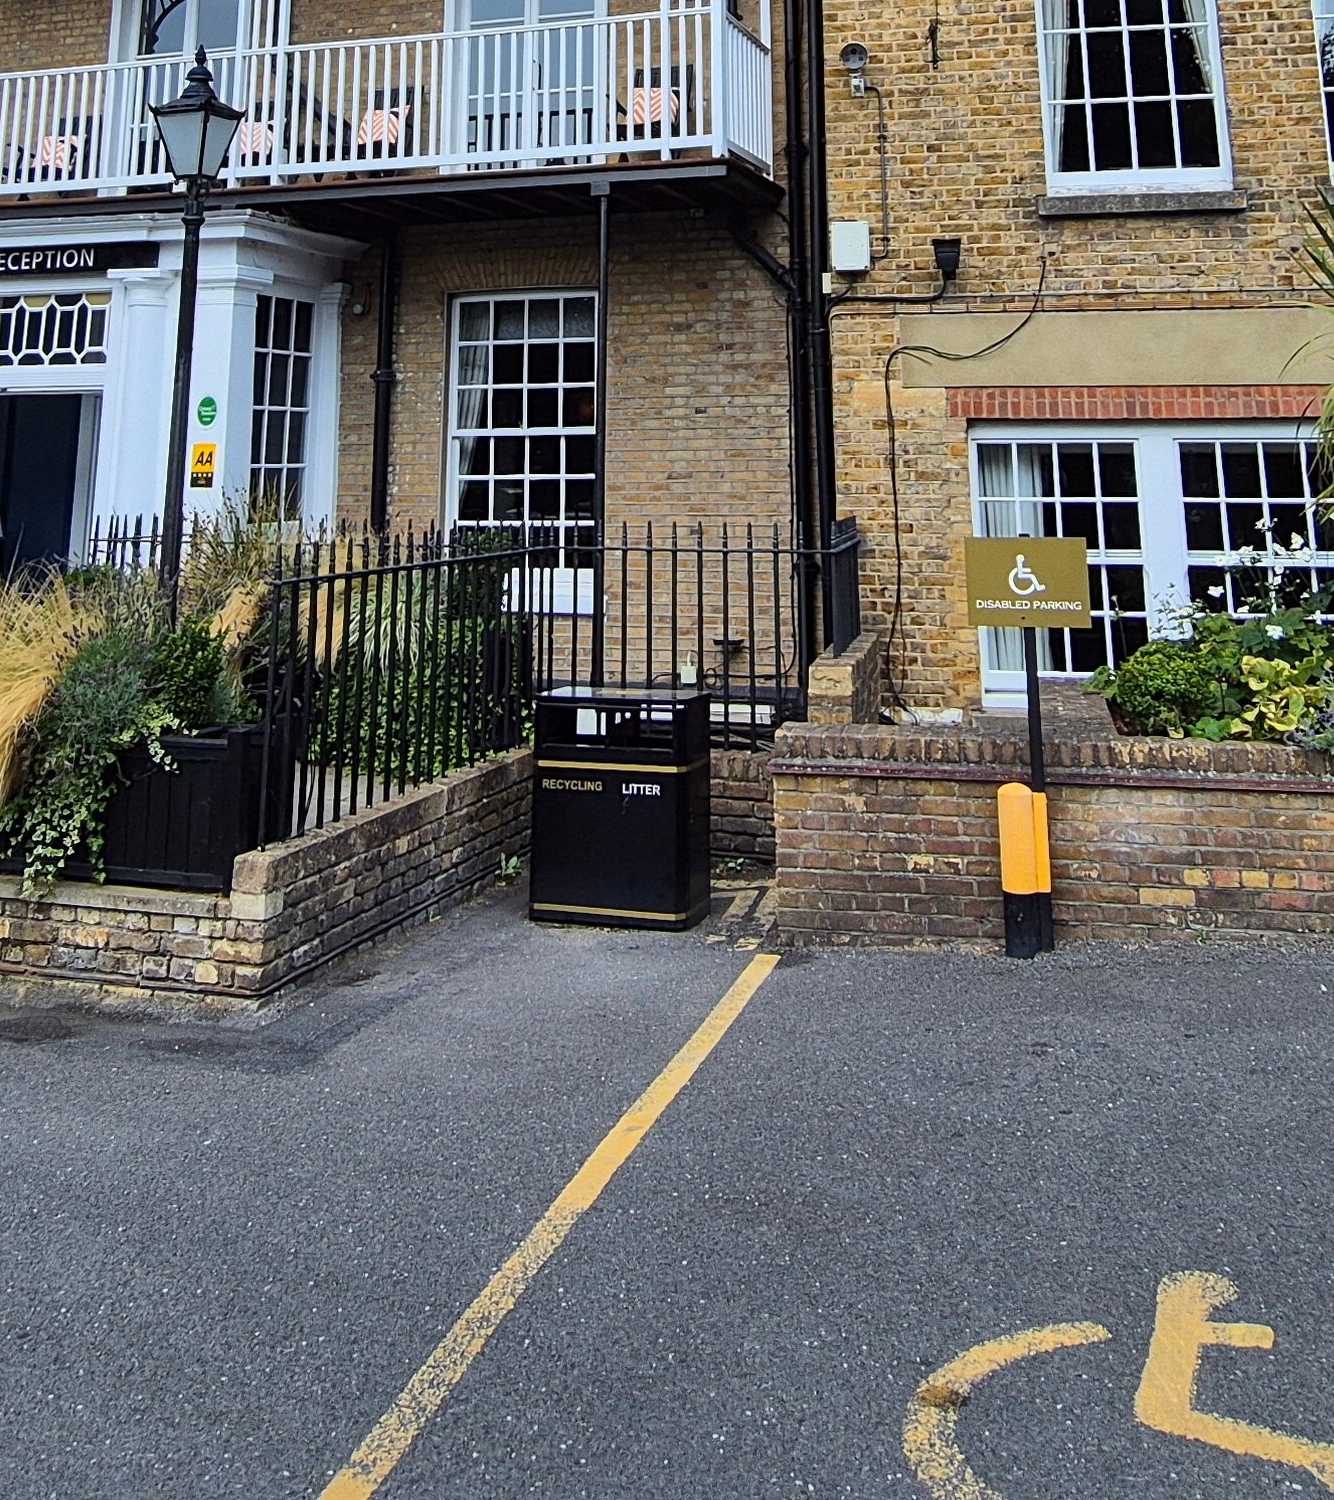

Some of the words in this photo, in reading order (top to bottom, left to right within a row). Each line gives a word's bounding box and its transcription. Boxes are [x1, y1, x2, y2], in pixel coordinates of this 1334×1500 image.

[195, 451, 214, 467] AA
[976, 600, 1031, 609] DISABLED
[1033, 601, 1083, 611] PARKING
[542, 778, 603, 792] RECYCLING
[622, 783, 661, 796] LITTER
